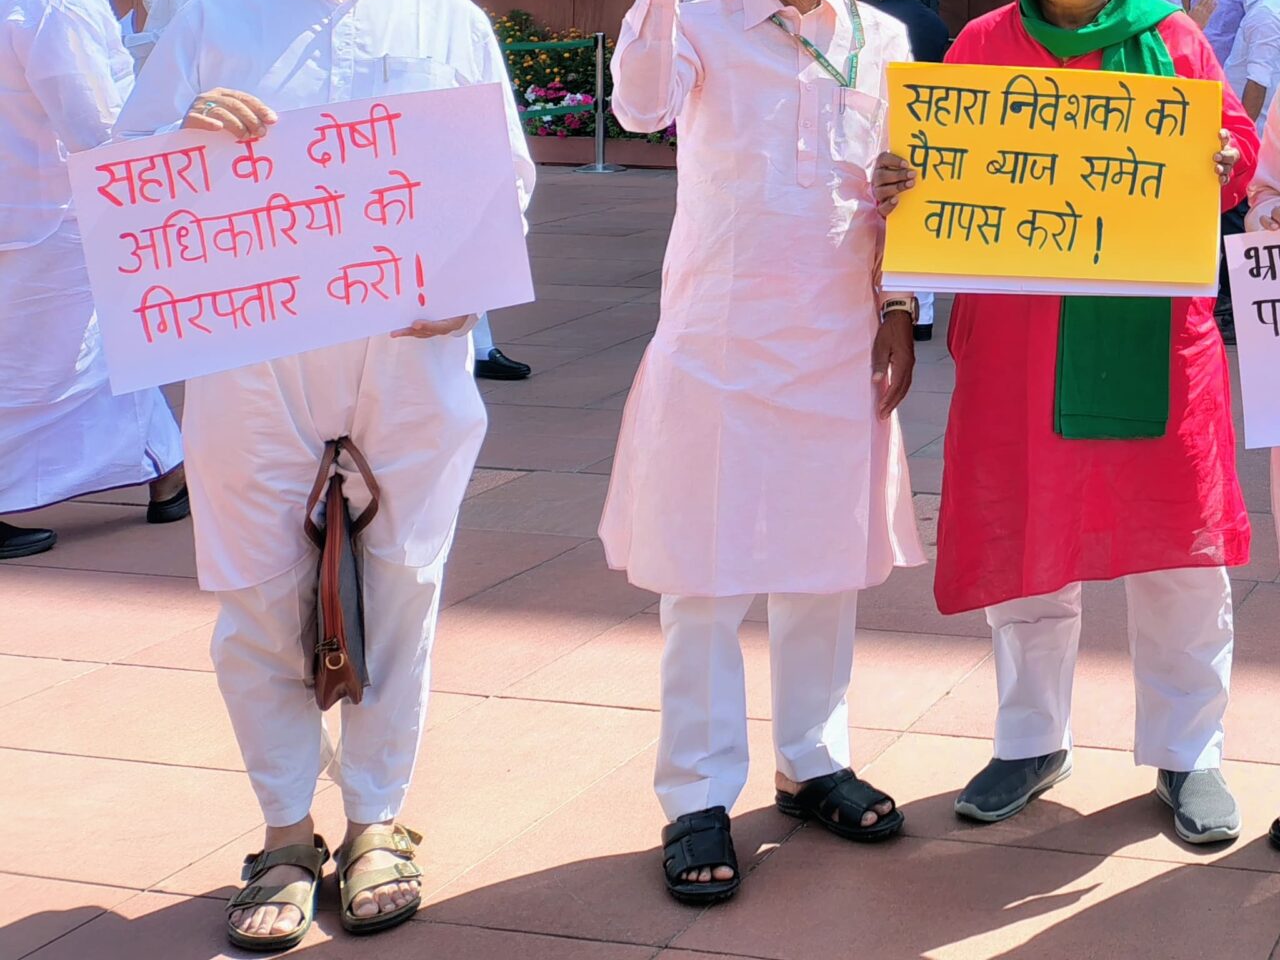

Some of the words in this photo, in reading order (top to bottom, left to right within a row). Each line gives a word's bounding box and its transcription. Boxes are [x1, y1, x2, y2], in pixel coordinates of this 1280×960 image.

[903, 83, 990, 127] सहारा
[1000, 74, 1135, 133] निवेशको
[1145, 86, 1190, 137] को
[95, 144, 212, 206] सहारा
[306, 102, 402, 169] दोषी
[907, 129, 969, 182] पैसा
[986, 149, 1059, 186] ब्याज
[1080, 146, 1167, 199] समेत
[117, 185, 345, 275] अधिकारियों
[364, 170, 422, 226] को
[925, 200, 1006, 245] वापस
